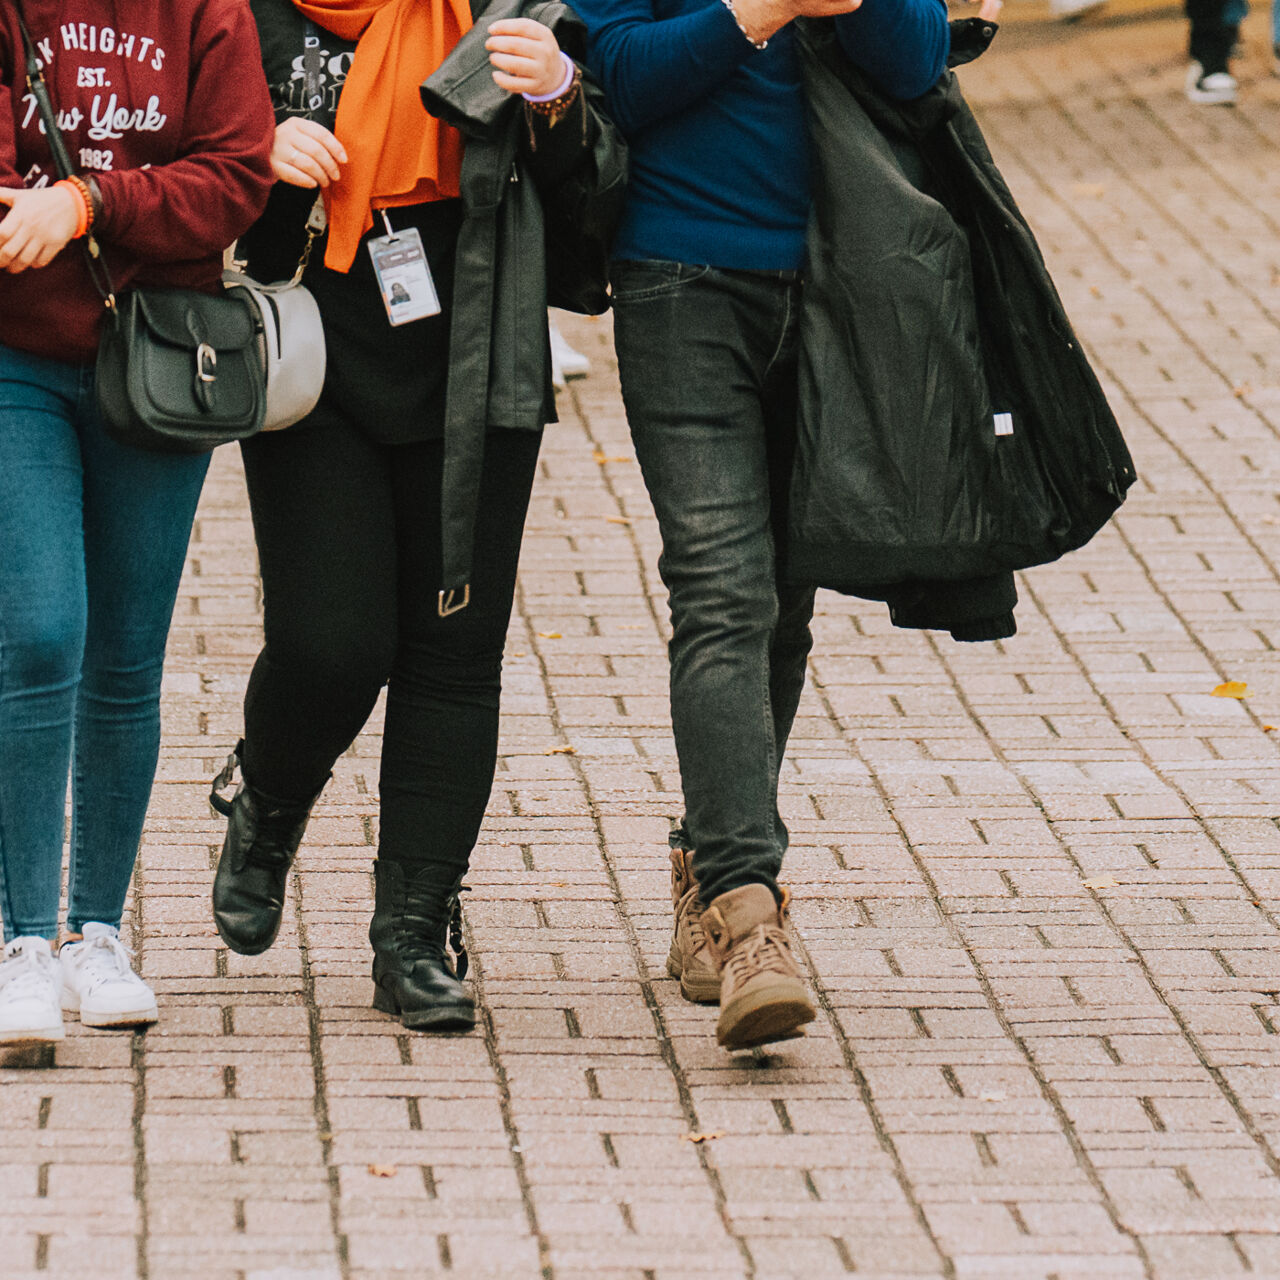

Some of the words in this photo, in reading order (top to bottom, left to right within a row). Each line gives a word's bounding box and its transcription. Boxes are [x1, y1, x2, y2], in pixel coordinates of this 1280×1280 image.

[60, 22, 166, 71] HEIGHTS
[77, 66, 111, 88] EST.
[88, 93, 167, 141] York
[78, 148, 113, 171] 1982
